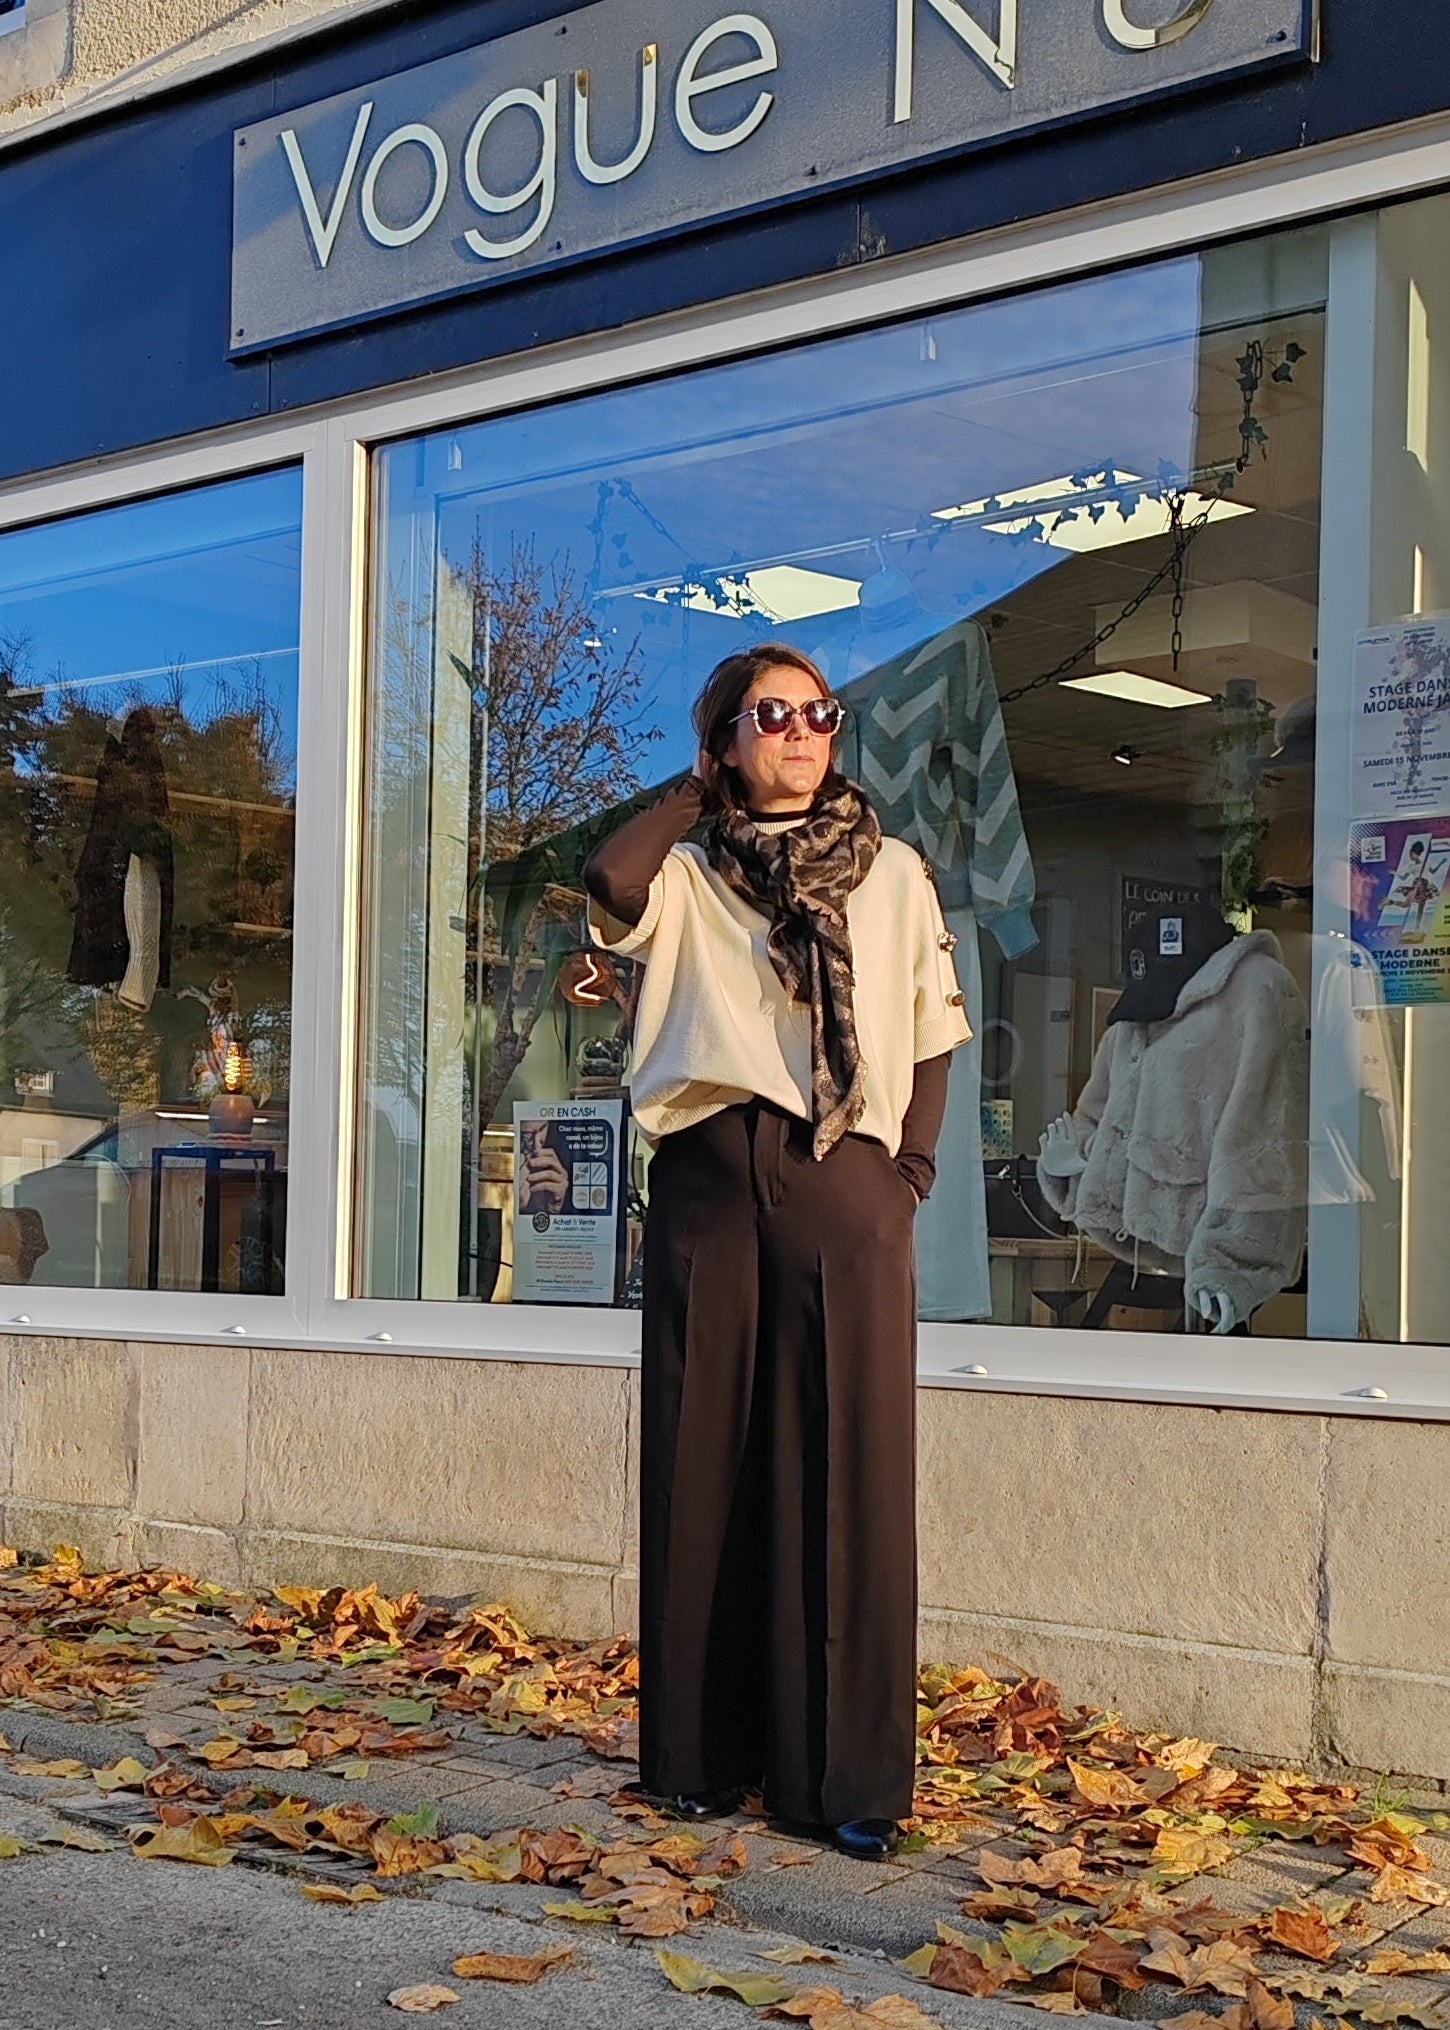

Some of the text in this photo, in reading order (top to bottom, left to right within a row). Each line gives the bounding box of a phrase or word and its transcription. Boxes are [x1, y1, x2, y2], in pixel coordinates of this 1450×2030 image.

[281, 14, 778, 268] Vogue
[1369, 676, 1450, 699] STAGE DAN
[1363, 693, 1434, 714] MODERNE
[1363, 756, 1394, 768] SAMEDI
[1396, 755, 1404, 766] 15
[1371, 948, 1409, 960] STAGE
[1380, 958, 1441, 971] MODERNE
[540, 1107, 596, 1118] OR EN CASH
[552, 1218, 572, 1226] Achat
[578, 1218, 596, 1226] Vente
